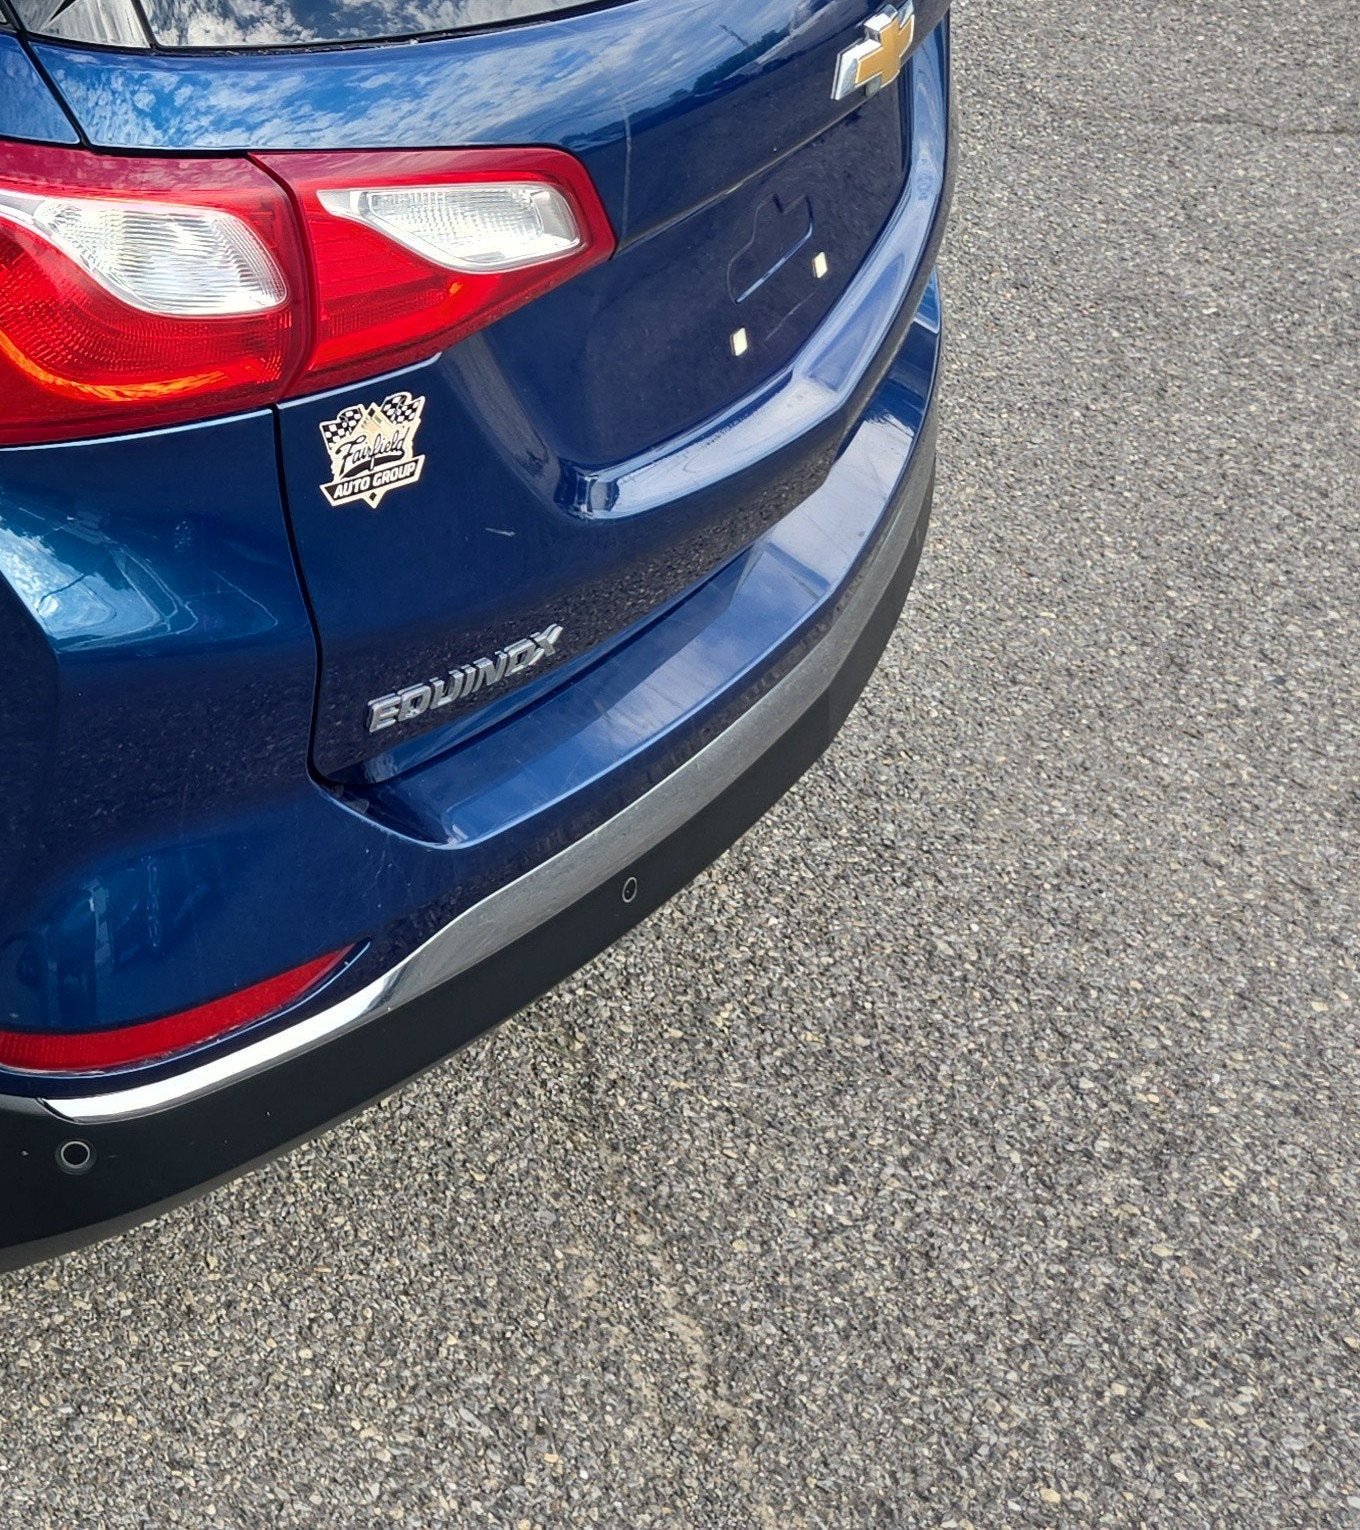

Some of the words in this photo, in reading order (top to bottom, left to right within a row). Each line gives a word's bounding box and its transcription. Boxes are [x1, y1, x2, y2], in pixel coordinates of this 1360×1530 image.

[335, 427, 410, 473] Fairfield
[333, 476, 370, 499] AUTO
[372, 462, 416, 487] GROUP
[366, 623, 564, 733] EQUINOX
